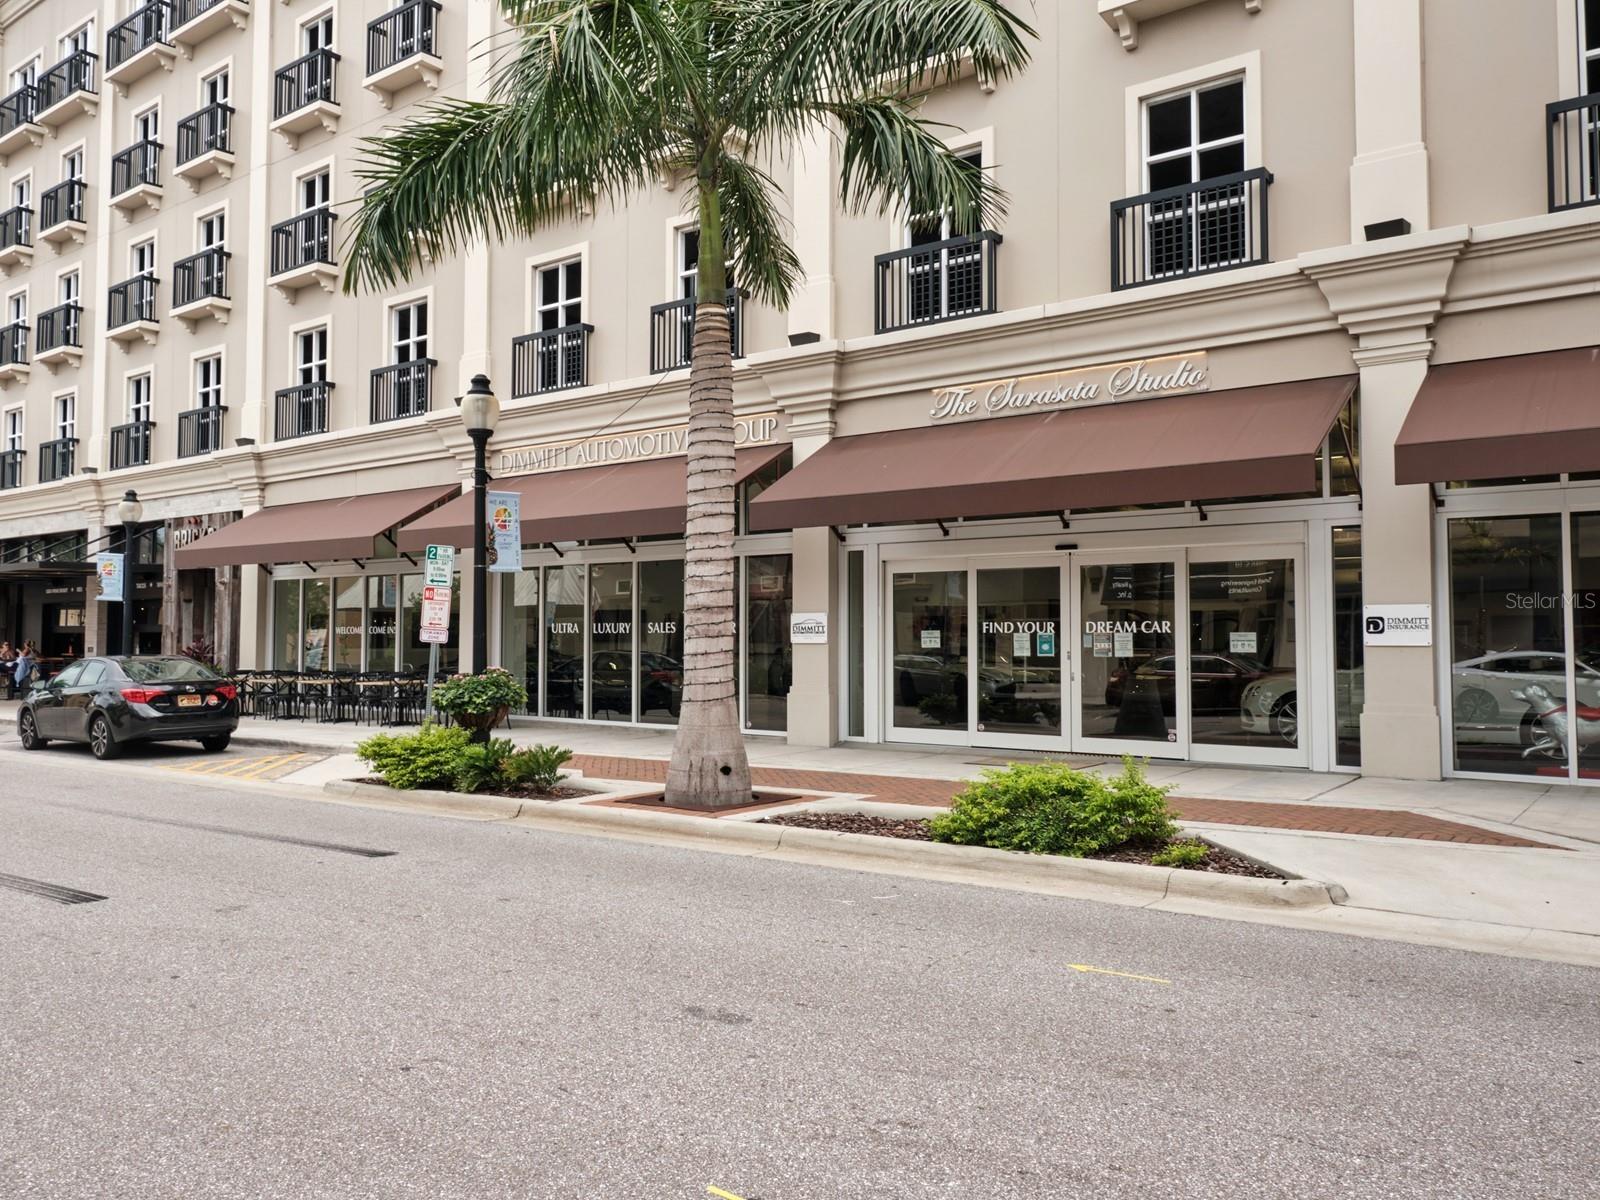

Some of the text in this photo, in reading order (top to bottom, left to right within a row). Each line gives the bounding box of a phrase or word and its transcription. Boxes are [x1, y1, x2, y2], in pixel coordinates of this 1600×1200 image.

[929, 359, 1206, 419] The Sarasota Studio
[500, 417, 777, 474] DIMMITT AUTOMOTIV OUP
[429, 547, 436, 559] 2
[425, 590, 434, 599] NO
[335, 626, 363, 635] WELCOME
[368, 626, 386, 635] COME
[551, 621, 676, 635] ULTRA LUXURY SALES
[982, 620, 1172, 634] FIND YOUR DREAM CAR
